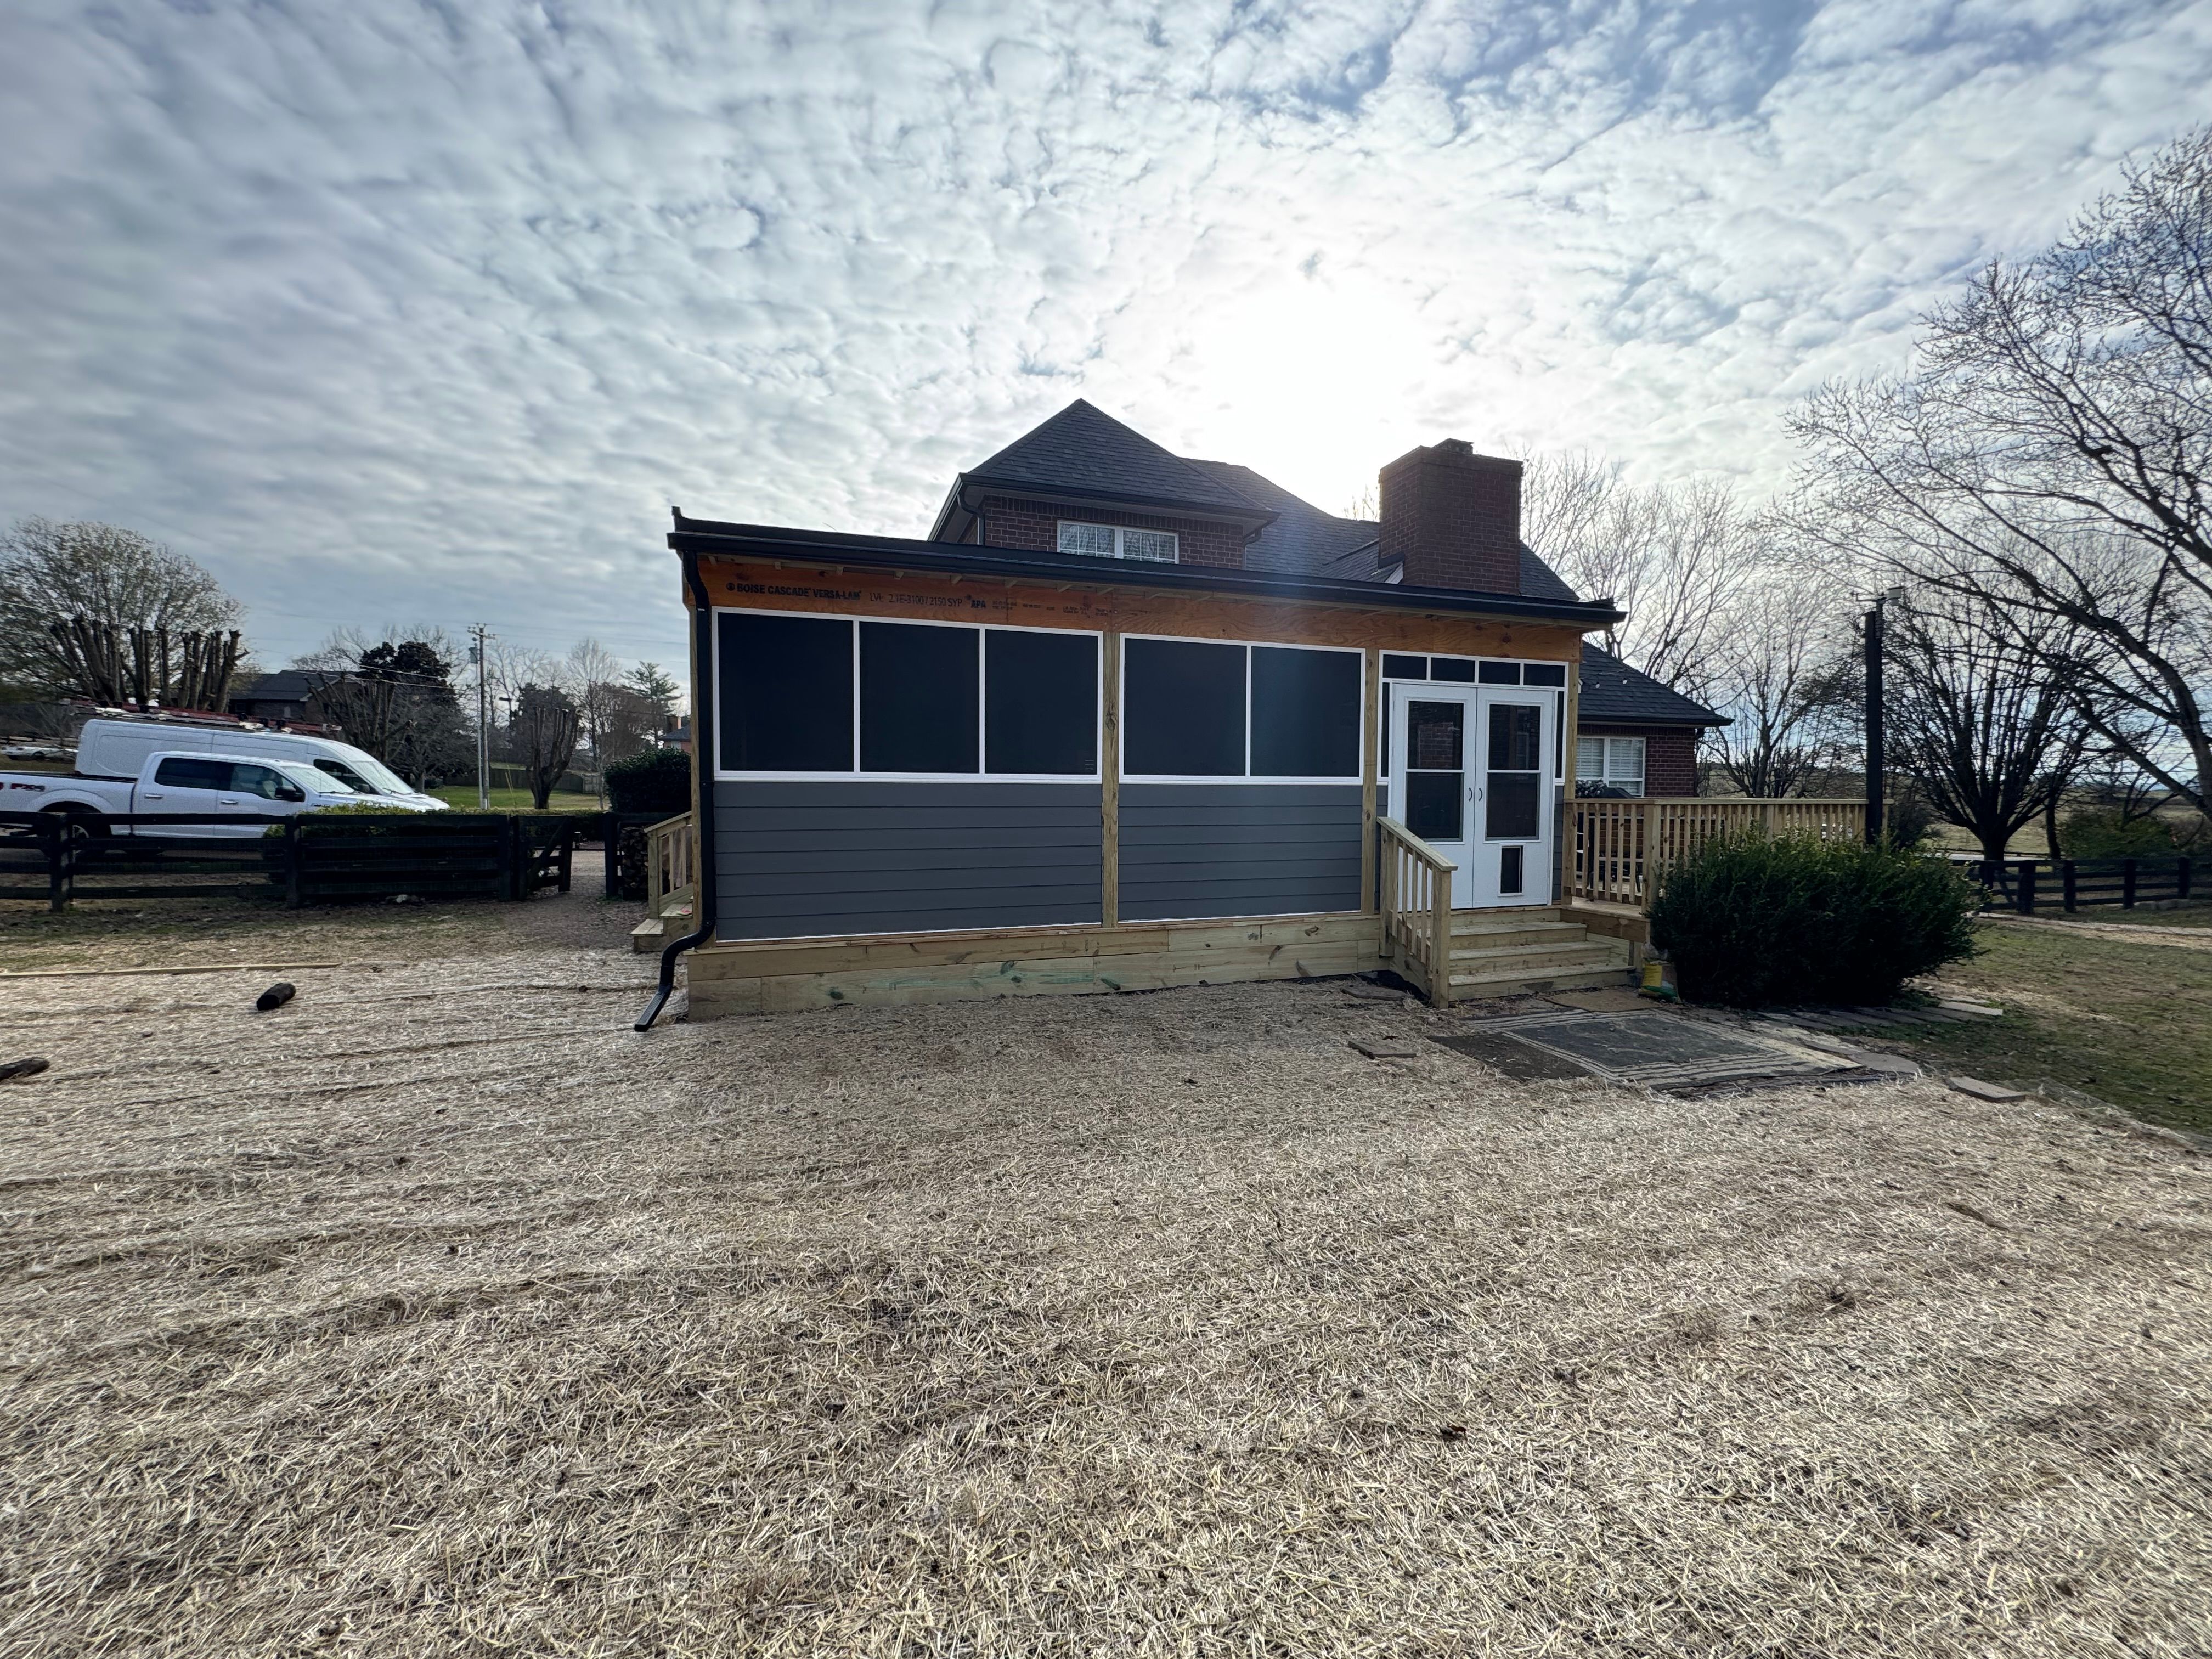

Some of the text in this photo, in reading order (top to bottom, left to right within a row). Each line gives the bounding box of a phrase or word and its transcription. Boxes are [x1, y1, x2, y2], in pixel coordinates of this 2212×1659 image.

[737, 583, 765, 594] BOISE
[947, 597, 963, 607] SYP
[10, 783, 46, 792] FX4
